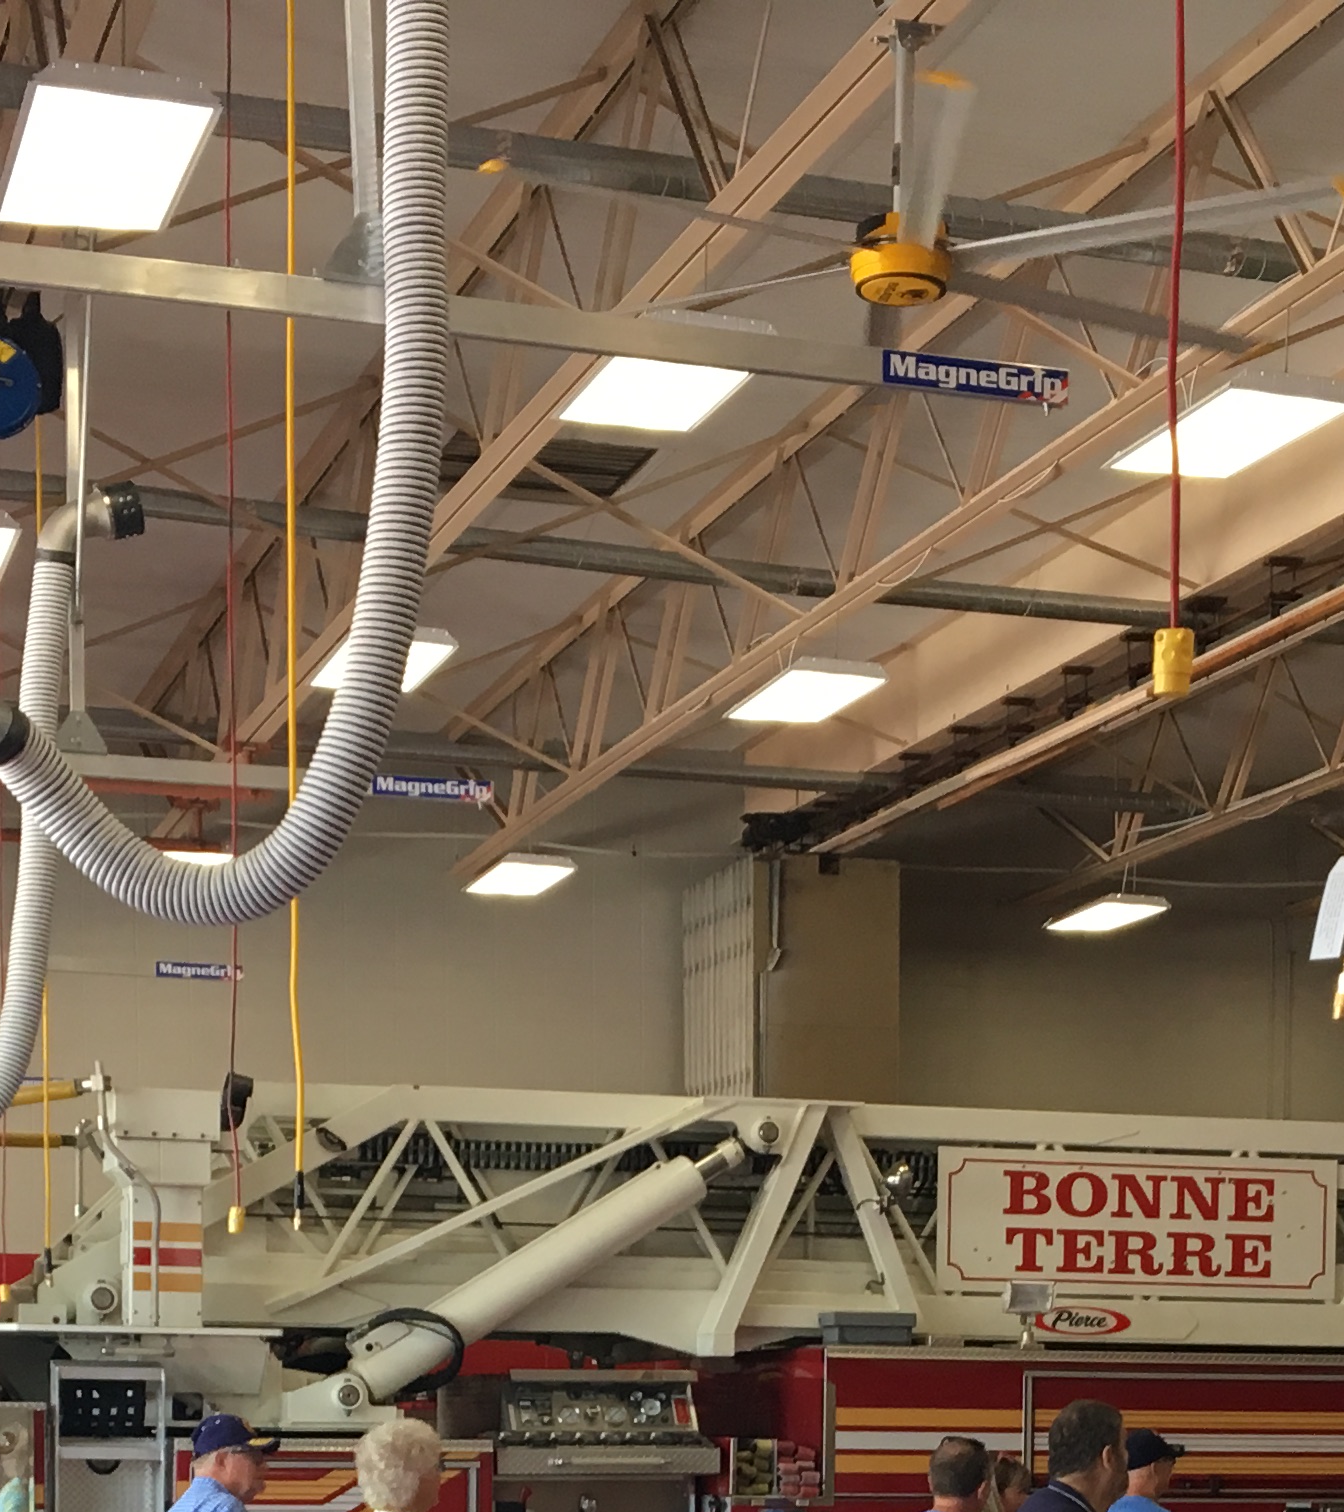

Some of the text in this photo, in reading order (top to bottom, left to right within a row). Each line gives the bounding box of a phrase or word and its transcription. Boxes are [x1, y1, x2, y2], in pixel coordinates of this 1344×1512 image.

[889, 353, 1065, 404] MagneGrip
[376, 776, 490, 803] MagneGrip
[1002, 1169, 1275, 1223] BONNE
[1005, 1227, 1273, 1278] TERRE
[1051, 1309, 1108, 1329] Pierce
